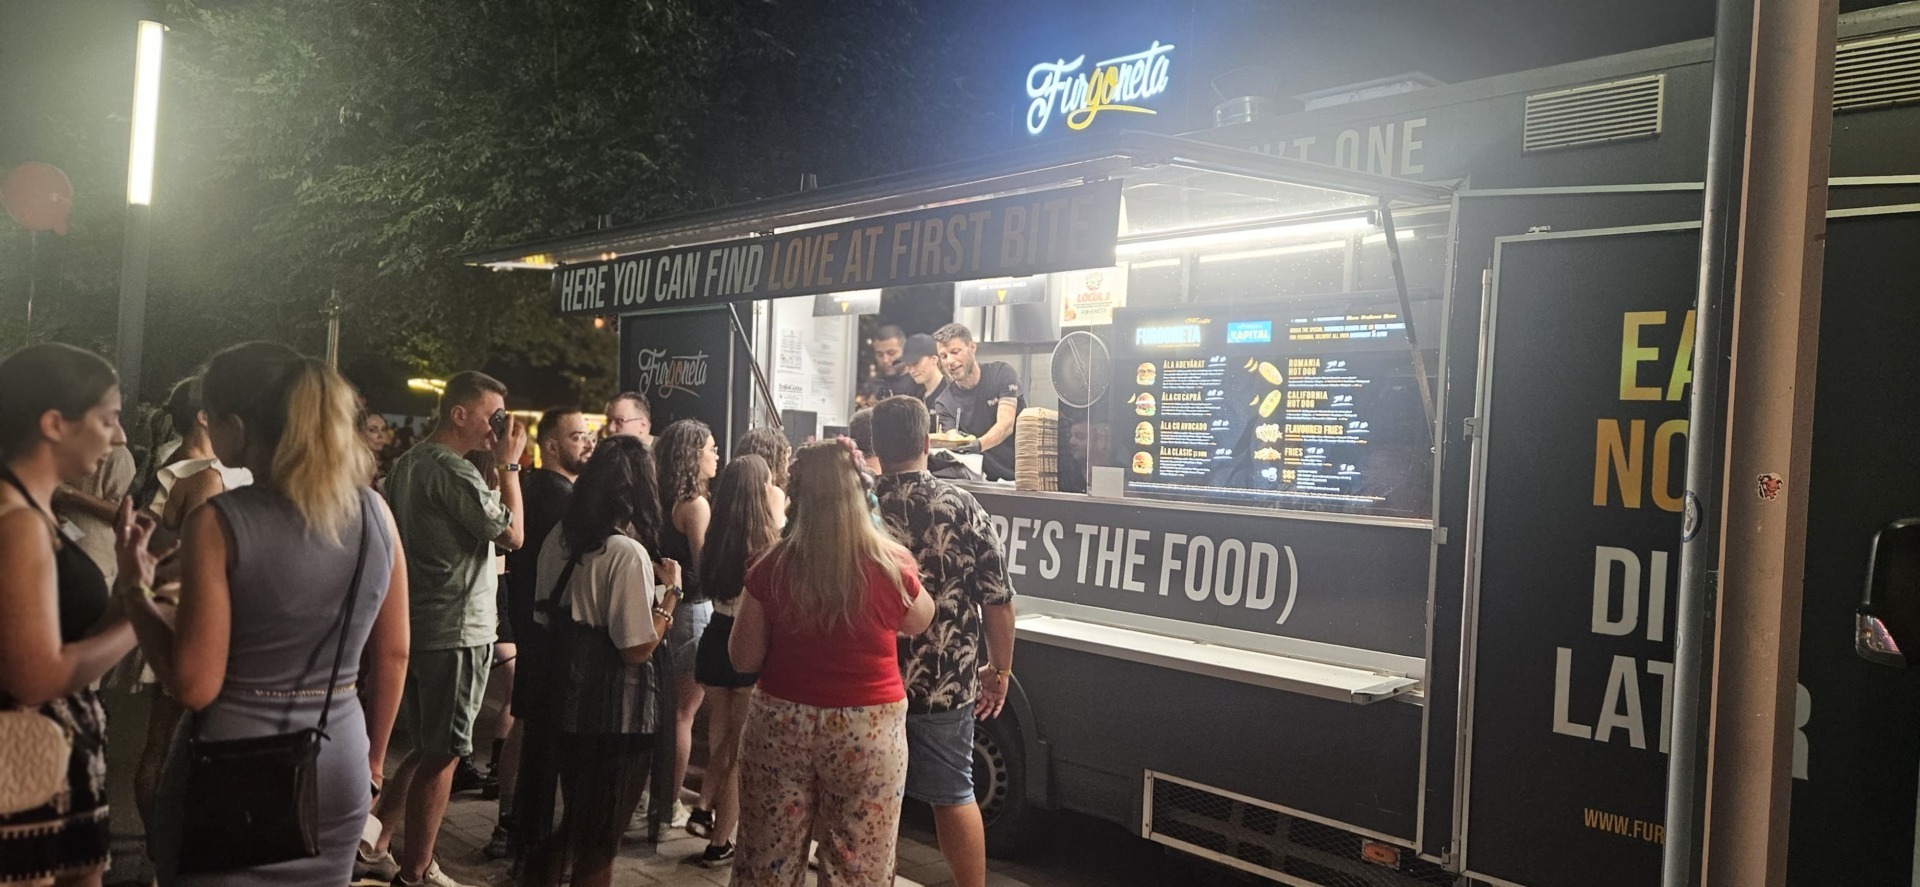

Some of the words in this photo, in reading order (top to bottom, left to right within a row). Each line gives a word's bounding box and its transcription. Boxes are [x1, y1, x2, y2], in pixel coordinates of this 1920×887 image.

[1026, 40, 1175, 134] Furgoneta
[1334, 118, 1427, 177] ONE
[561, 265, 609, 312] HERE
[614, 259, 652, 306] YOU
[655, 252, 701, 302] CAN
[704, 244, 764, 297] FIND
[767, 232, 839, 291] LOVE
[840, 226, 884, 284] AT
[890, 209, 992, 280] FIRST
[1001, 197, 1098, 269] BITE
[1077, 293, 1103, 303] LOCUL
[1620, 309, 1696, 401] EA
[1288, 358, 1321, 367] ROMANIA
[638, 348, 709, 399] Furgoneta
[1288, 367, 1302, 376] HOT
[1302, 367, 1317, 376] DOG
[1173, 393, 1181, 401] CU
[1287, 390, 1328, 400] CALIFORNIA
[1286, 399, 1300, 408] HOT
[1300, 399, 1315, 408] DOG
[1172, 422, 1180, 430] CU
[1181, 422, 1208, 431] AVOCADO
[1285, 424, 1323, 434] FLAVOURED
[1323, 425, 1344, 435] FRIES
[1171, 447, 1193, 457] CLASIC
[1284, 447, 1304, 457] FRIES
[1592, 418, 1689, 513] NO
[1282, 470, 1296, 480] SOS
[1075, 523, 1151, 593] THE
[1158, 533, 1299, 625] FOOD)
[1591, 545, 1668, 642] DI
[1552, 646, 1812, 781] LATR
[1584, 807, 1665, 845] WWW.FUR
